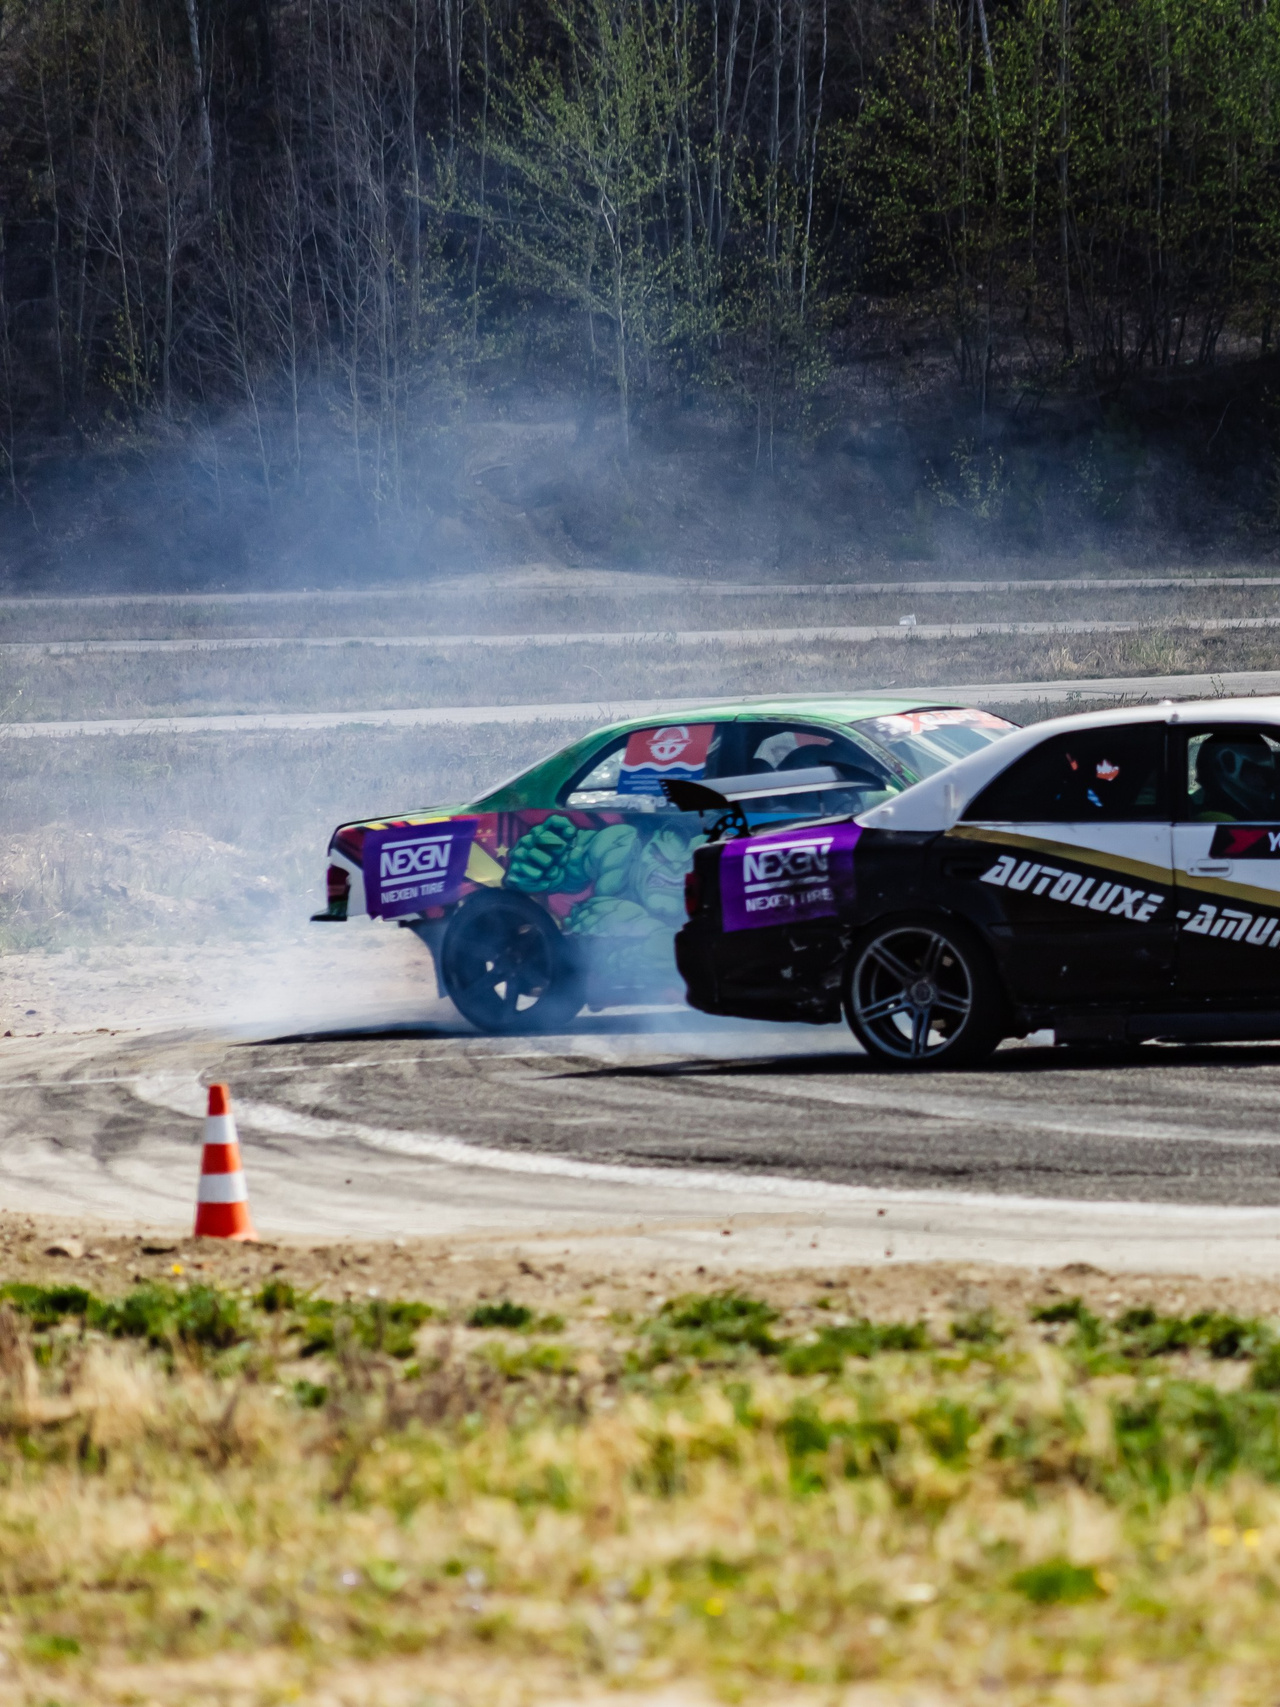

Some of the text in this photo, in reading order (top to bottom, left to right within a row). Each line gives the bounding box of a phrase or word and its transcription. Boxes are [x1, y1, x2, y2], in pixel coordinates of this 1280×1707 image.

[380, 843, 451, 877] NEXEN
[744, 844, 831, 882] NEXEN
[381, 881, 446, 904] NEXEN TIRE
[745, 893, 795, 912] NEXEN
